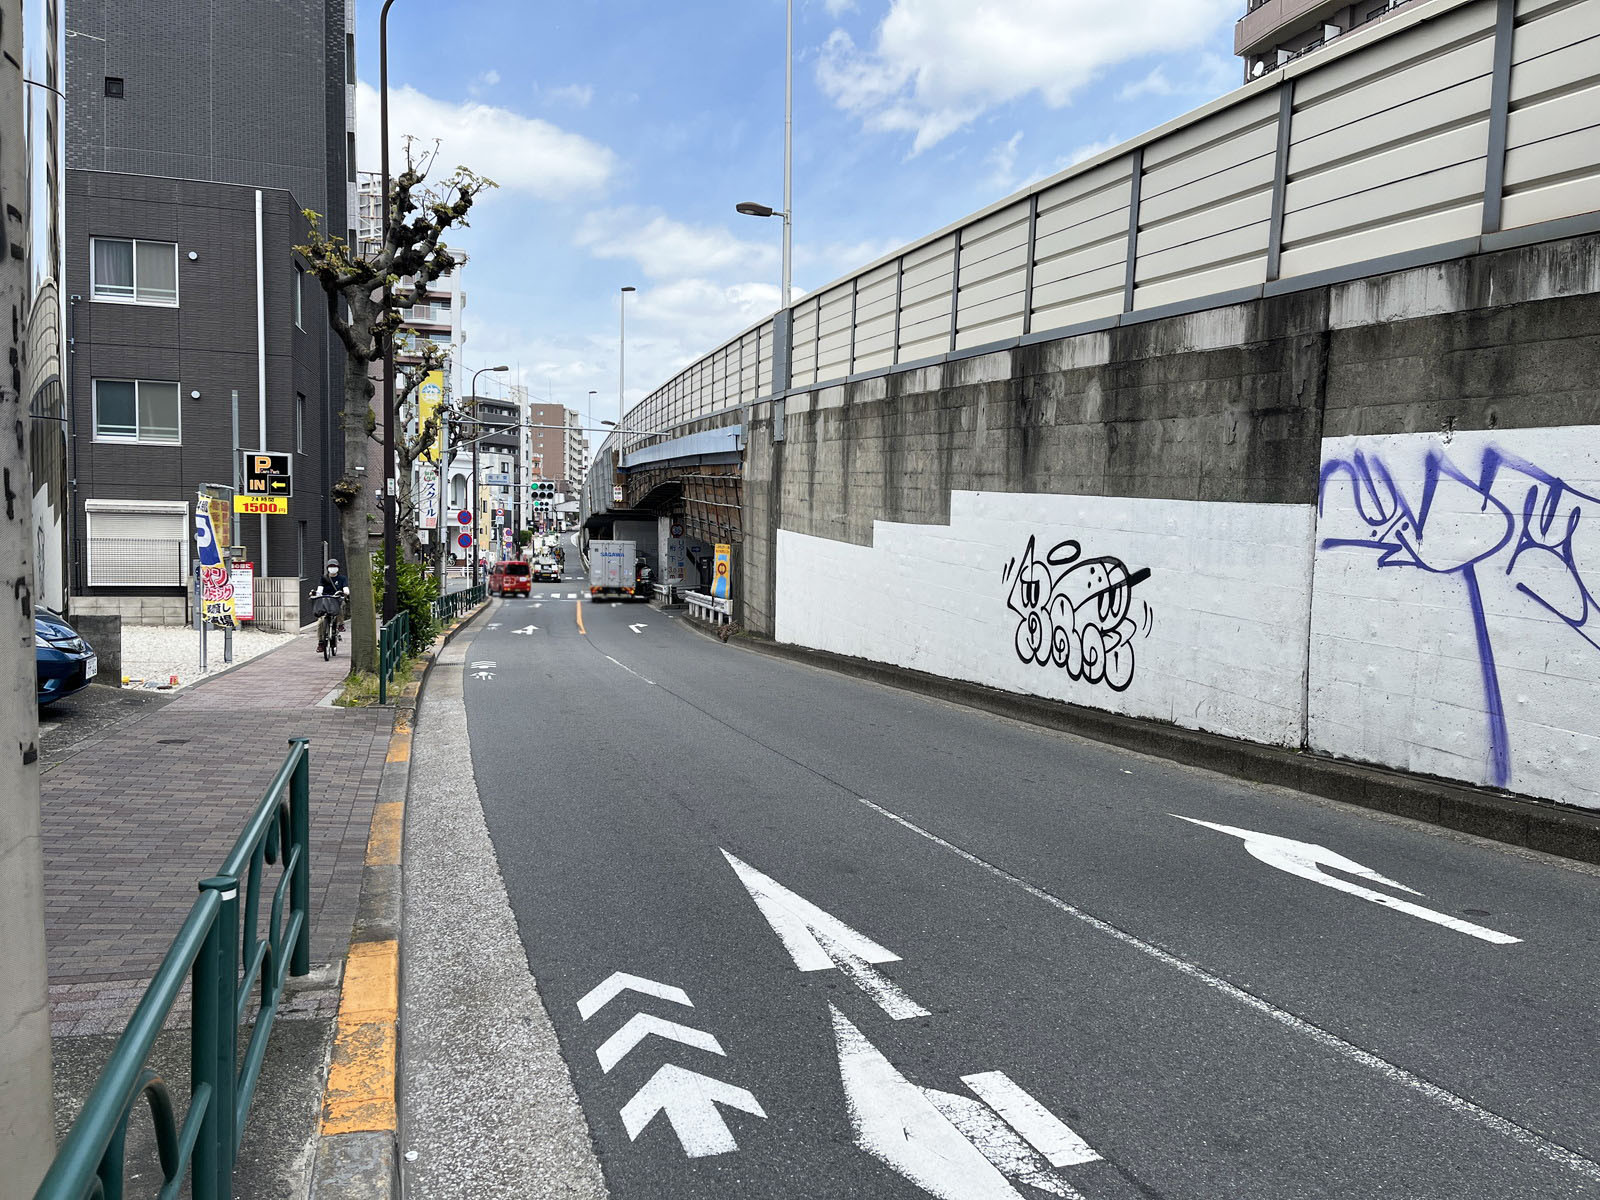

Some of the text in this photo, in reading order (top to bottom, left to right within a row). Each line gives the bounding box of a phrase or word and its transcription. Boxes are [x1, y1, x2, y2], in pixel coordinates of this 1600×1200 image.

[255, 456, 271, 474] P
[249, 479, 265, 491] IN
[426, 483, 437, 517] スクール
